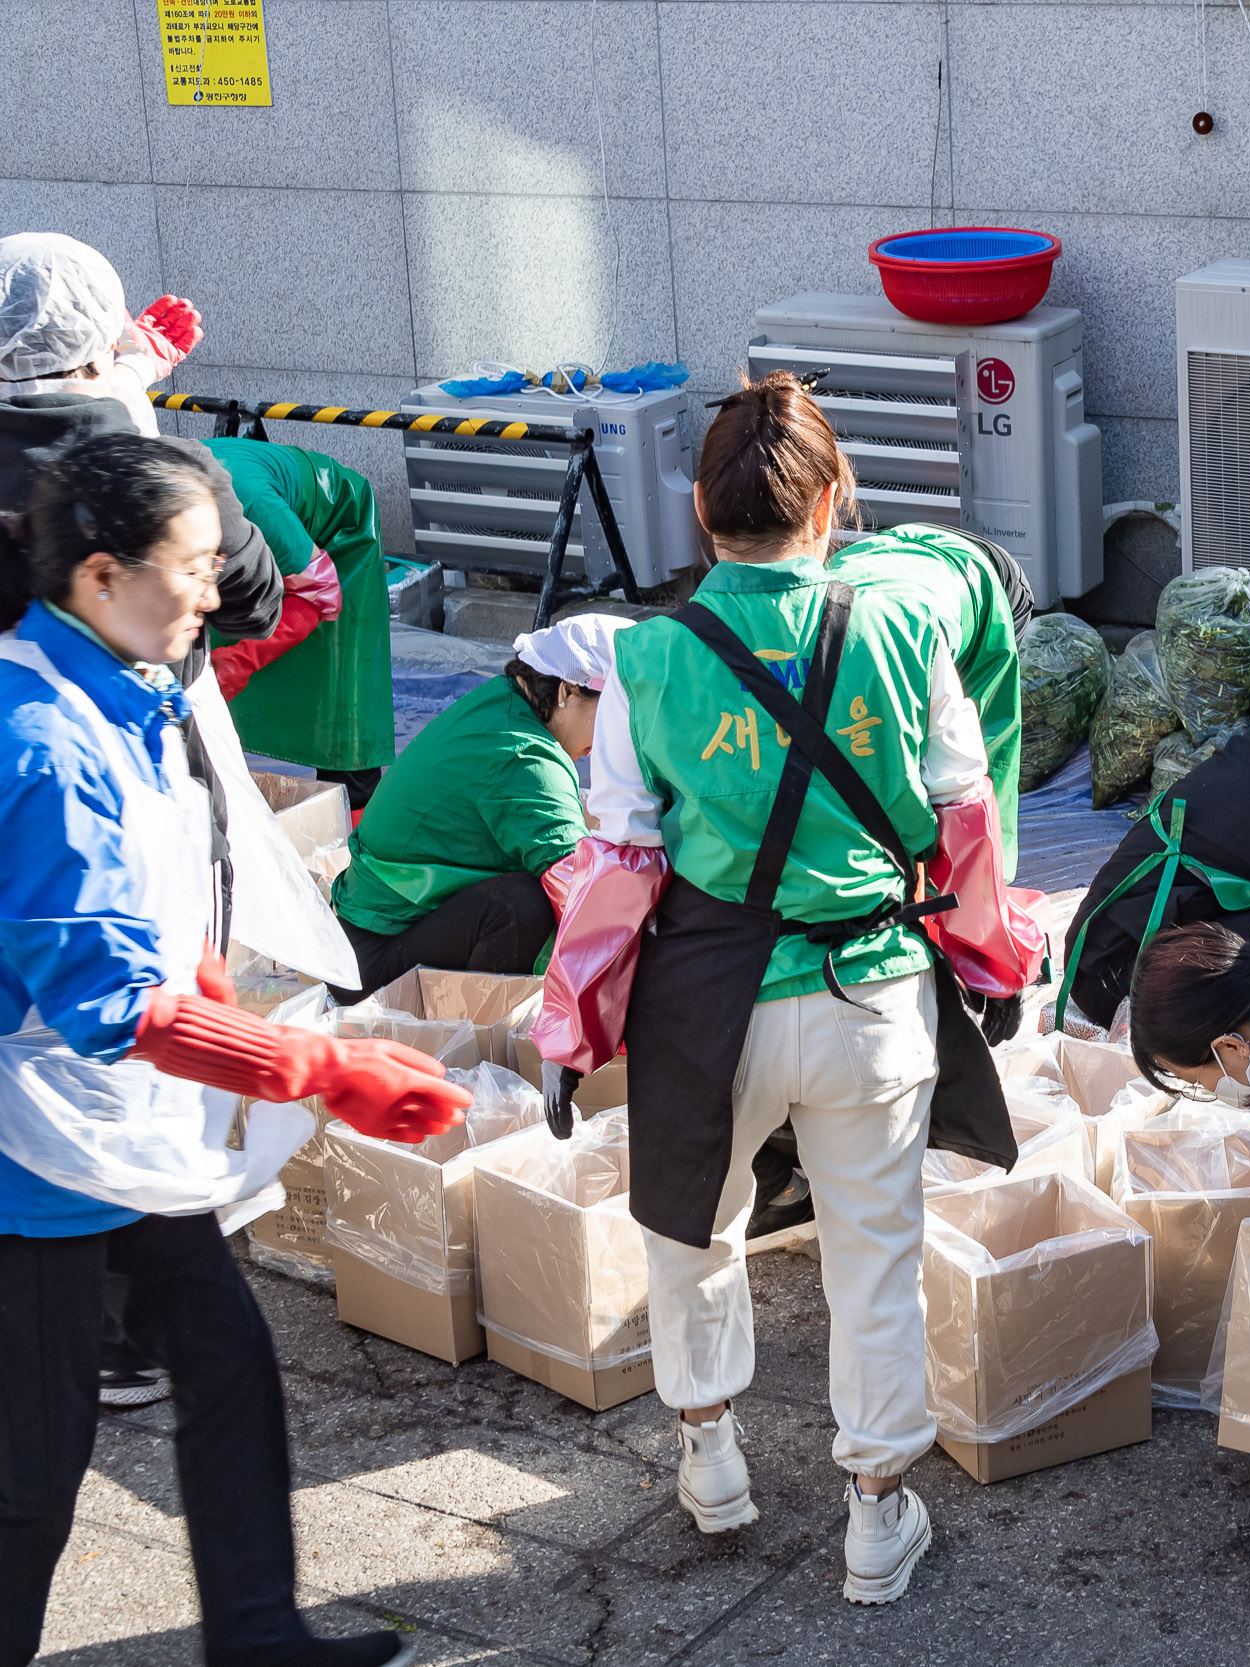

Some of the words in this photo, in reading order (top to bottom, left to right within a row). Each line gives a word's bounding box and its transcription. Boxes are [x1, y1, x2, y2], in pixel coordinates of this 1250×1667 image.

[164, 10, 195, 18] 제160조에
[214, 10, 235, 18] 20만원
[238, 10, 258, 18] 이하의
[167, 35, 202, 43] 불법주차를
[238, 35, 260, 43] 주시기
[168, 47, 196, 55] 바랍니다.
[172, 77, 210, 86] 교통지도과
[205, 93, 247, 101] 광진구청장
[601, 422, 626, 435] UNG
[978, 412, 1012, 437] LG
[993, 527, 1027, 538] Inverter
[701, 695, 883, 771] 새을
